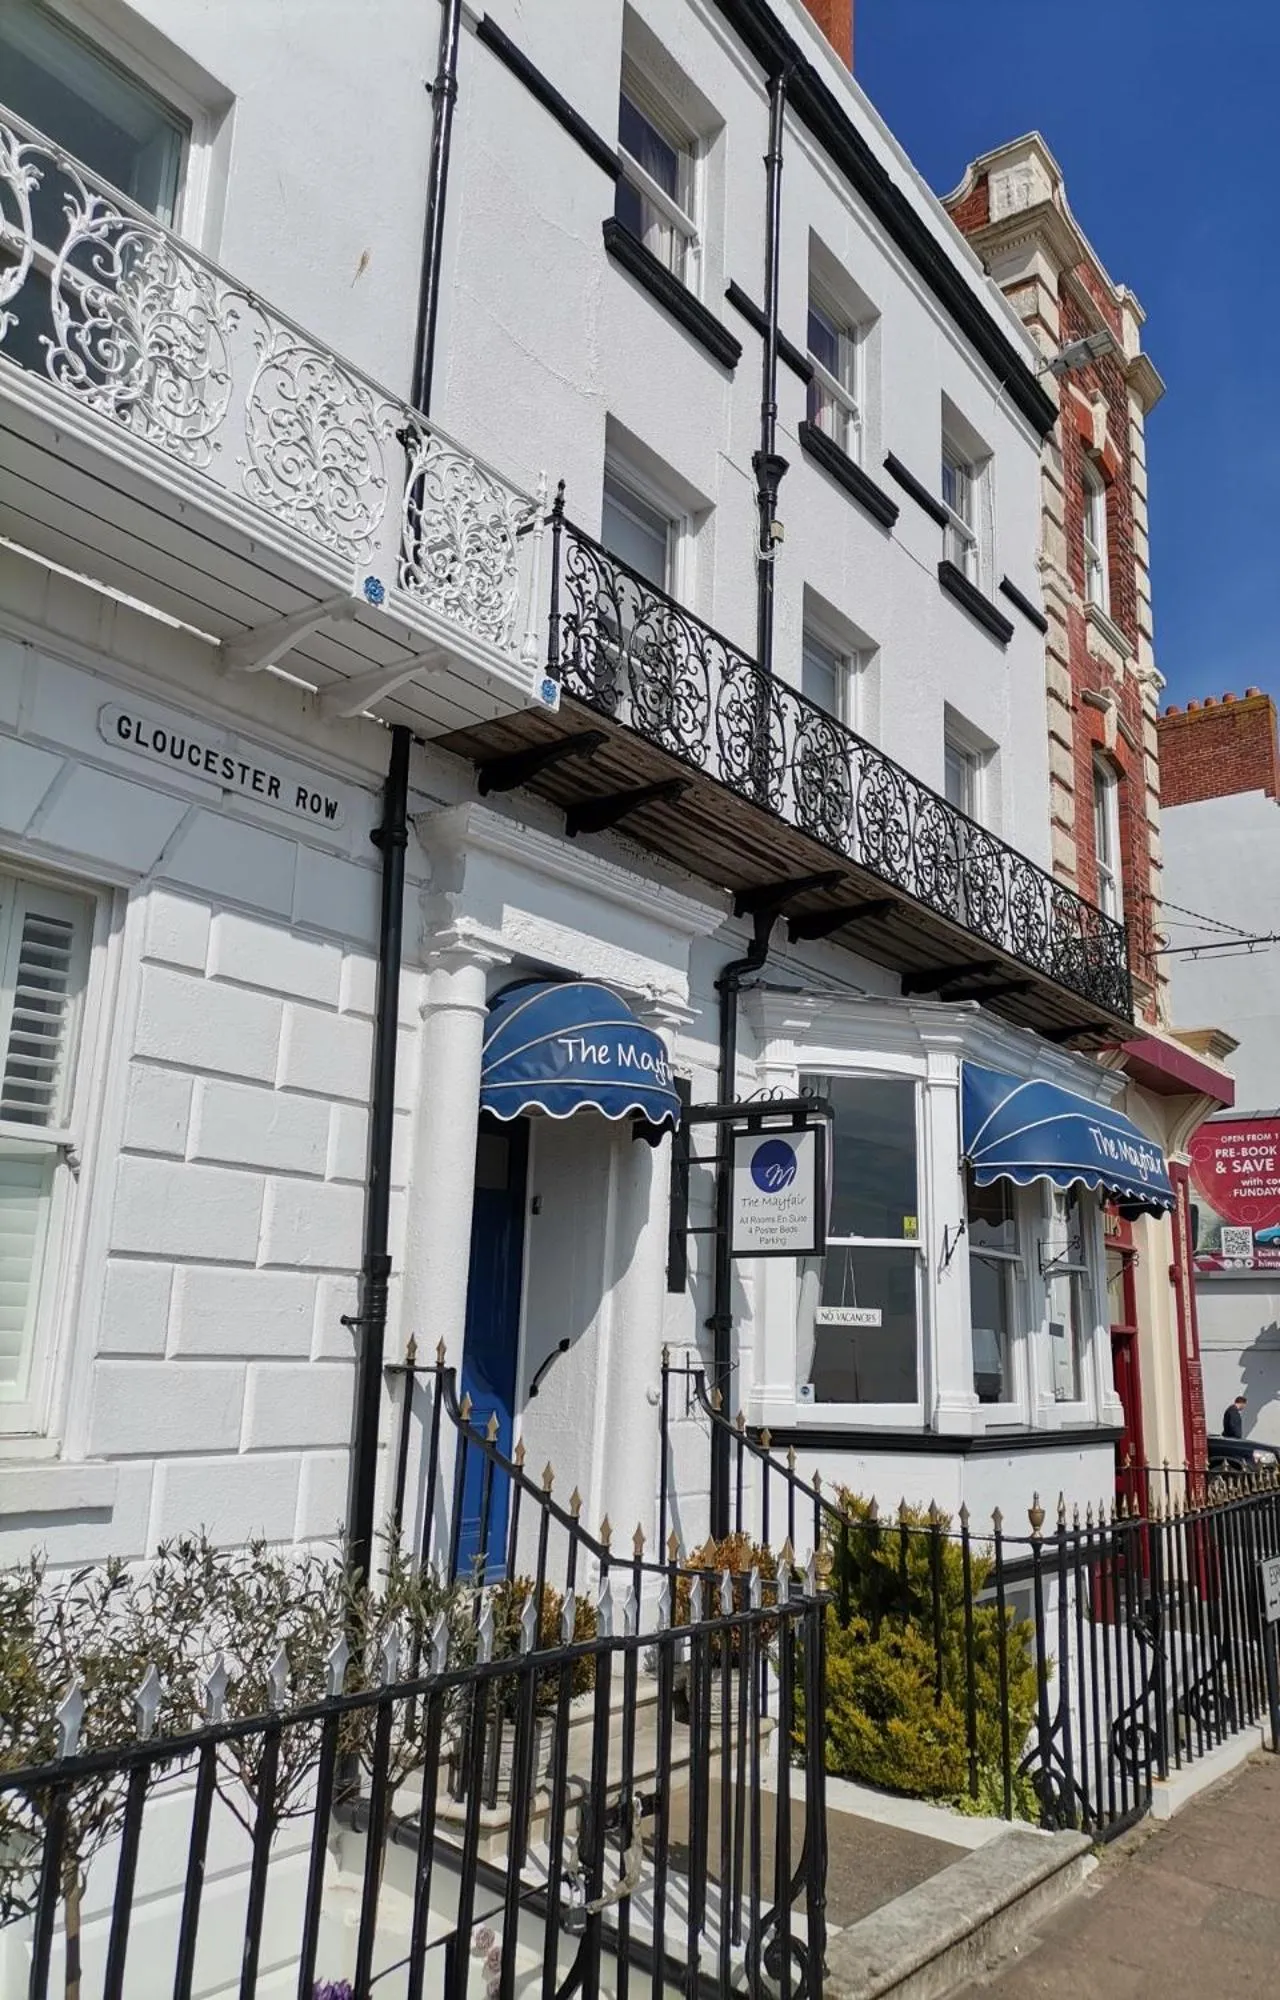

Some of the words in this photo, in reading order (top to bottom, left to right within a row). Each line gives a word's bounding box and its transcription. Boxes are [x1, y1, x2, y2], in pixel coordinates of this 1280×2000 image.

[116, 715, 281, 799] GLOUCESTER
[295, 786, 339, 820] ROW
[558, 1037, 611, 1065] The
[1221, 1135, 1245, 1144] OPEN
[1246, 1132, 1272, 1142] FROM
[1088, 1127, 1119, 1160] The
[1117, 1138, 1163, 1181] Mayfair
[1215, 1145, 1277, 1158] PRE-BOOK
[1215, 1161, 1227, 1174] &
[1232, 1158, 1275, 1174] SAVE
[1241, 1177, 1264, 1186] with
[741, 1196, 760, 1207] The
[762, 1193, 807, 1211] Mayfair
[750, 1215, 775, 1224] Rooms
[777, 1214, 786, 1223] En
[755, 1225, 778, 1234] Poster
[760, 1236, 787, 1246] Parking
[820, 1311, 834, 1321] NO
[836, 1311, 877, 1323] VACANCIES
